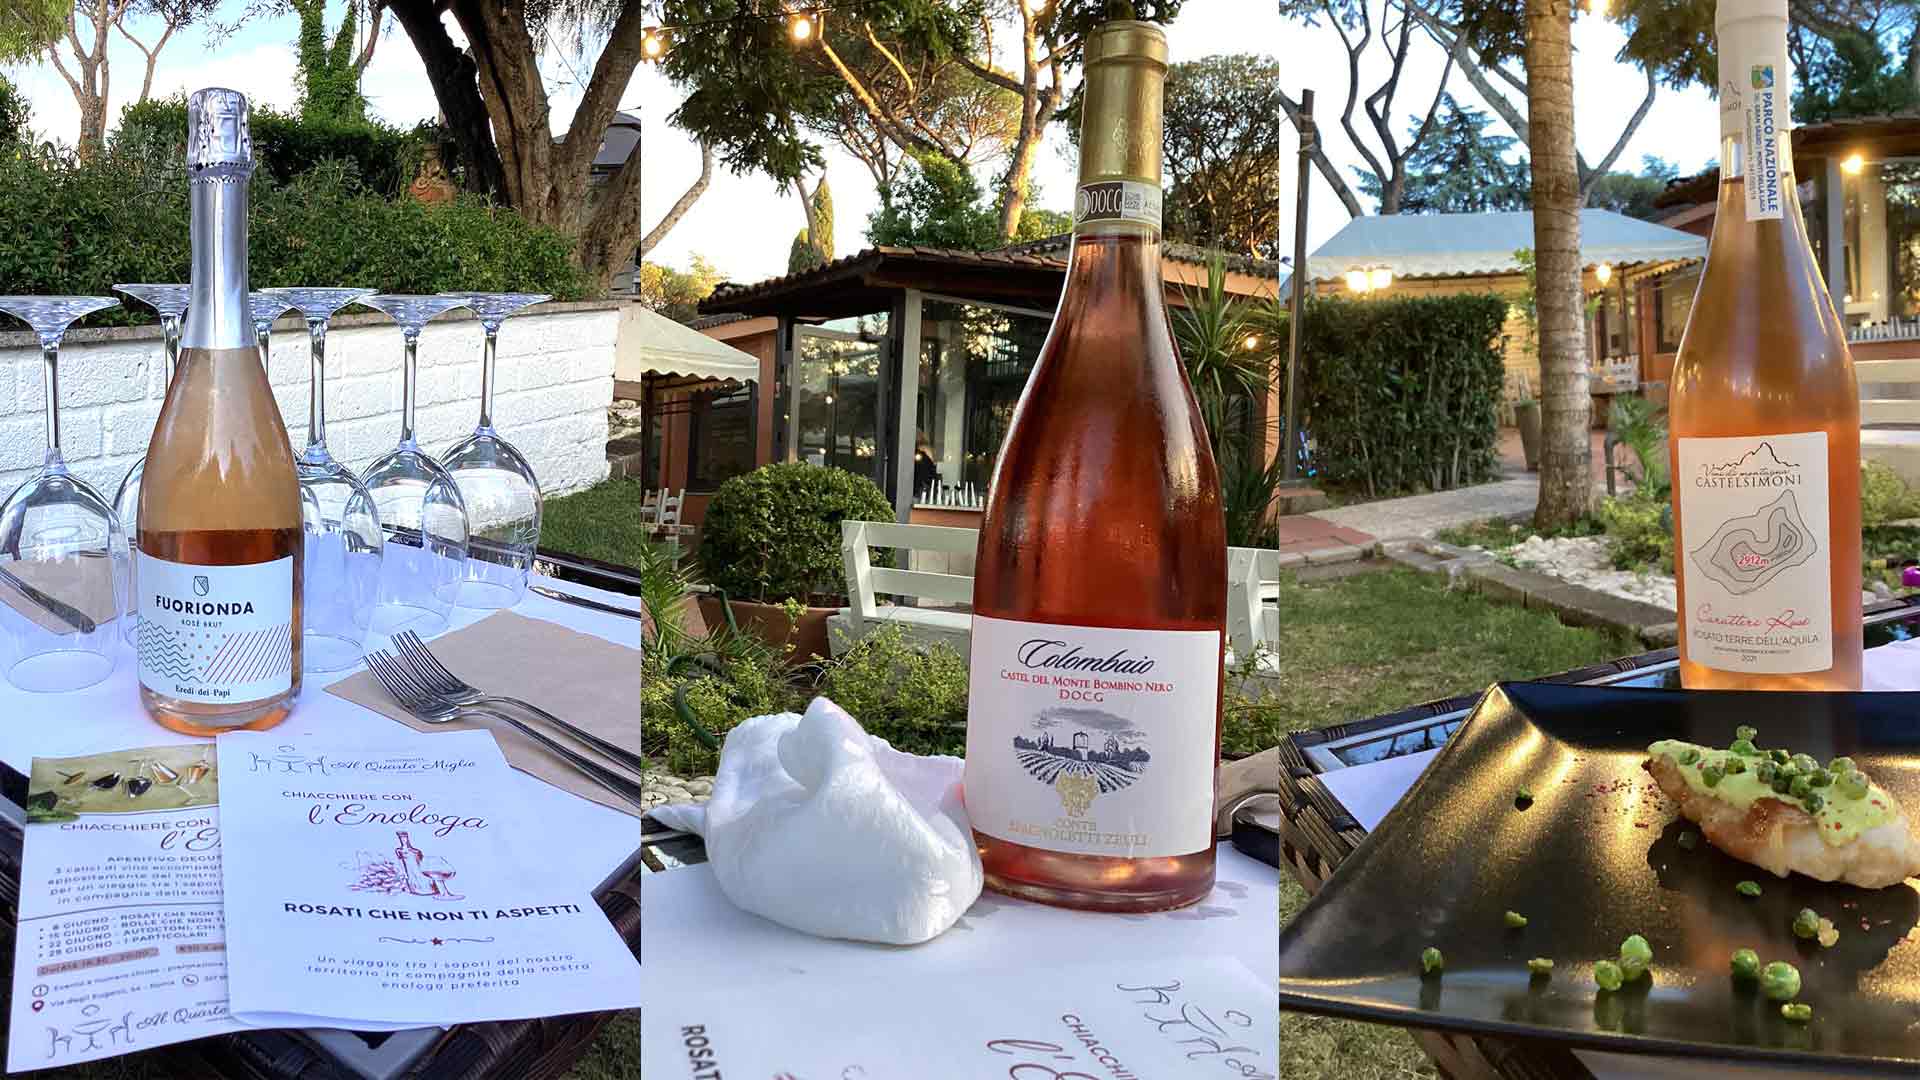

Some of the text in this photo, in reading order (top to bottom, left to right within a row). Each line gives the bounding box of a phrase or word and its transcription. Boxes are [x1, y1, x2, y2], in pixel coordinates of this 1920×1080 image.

[1763, 92, 1778, 211] PARCO NAZIONALE
[1695, 473, 1801, 489] CASTELSIMONI
[1738, 555, 1769, 566] 2912m
[155, 595, 255, 616] FUORIONDA
[204, 620, 223, 628] BRUT
[1725, 634, 1754, 646] TERRE
[1017, 639, 1155, 675] Colombaio
[175, 684, 195, 696] Eredi
[422, 759, 476, 773] Miglio
[282, 791, 413, 801] CHIACCHIERE CON
[60, 818, 211, 832] CHIACCHIERE CON
[308, 803, 489, 837] l'Enologa
[284, 902, 581, 921] ROSATI CHE NON TI ASPETTI
[317, 955, 336, 963] Un
[343, 957, 399, 968] viaggio
[406, 960, 427, 969] tra
[444, 960, 491, 969] sapori
[497, 957, 519, 966] del
[526, 954, 574, 964] nostro
[307, 963, 591, 980] territorio in compagnia della nostra
[381, 979, 520, 992] enologa preferita
